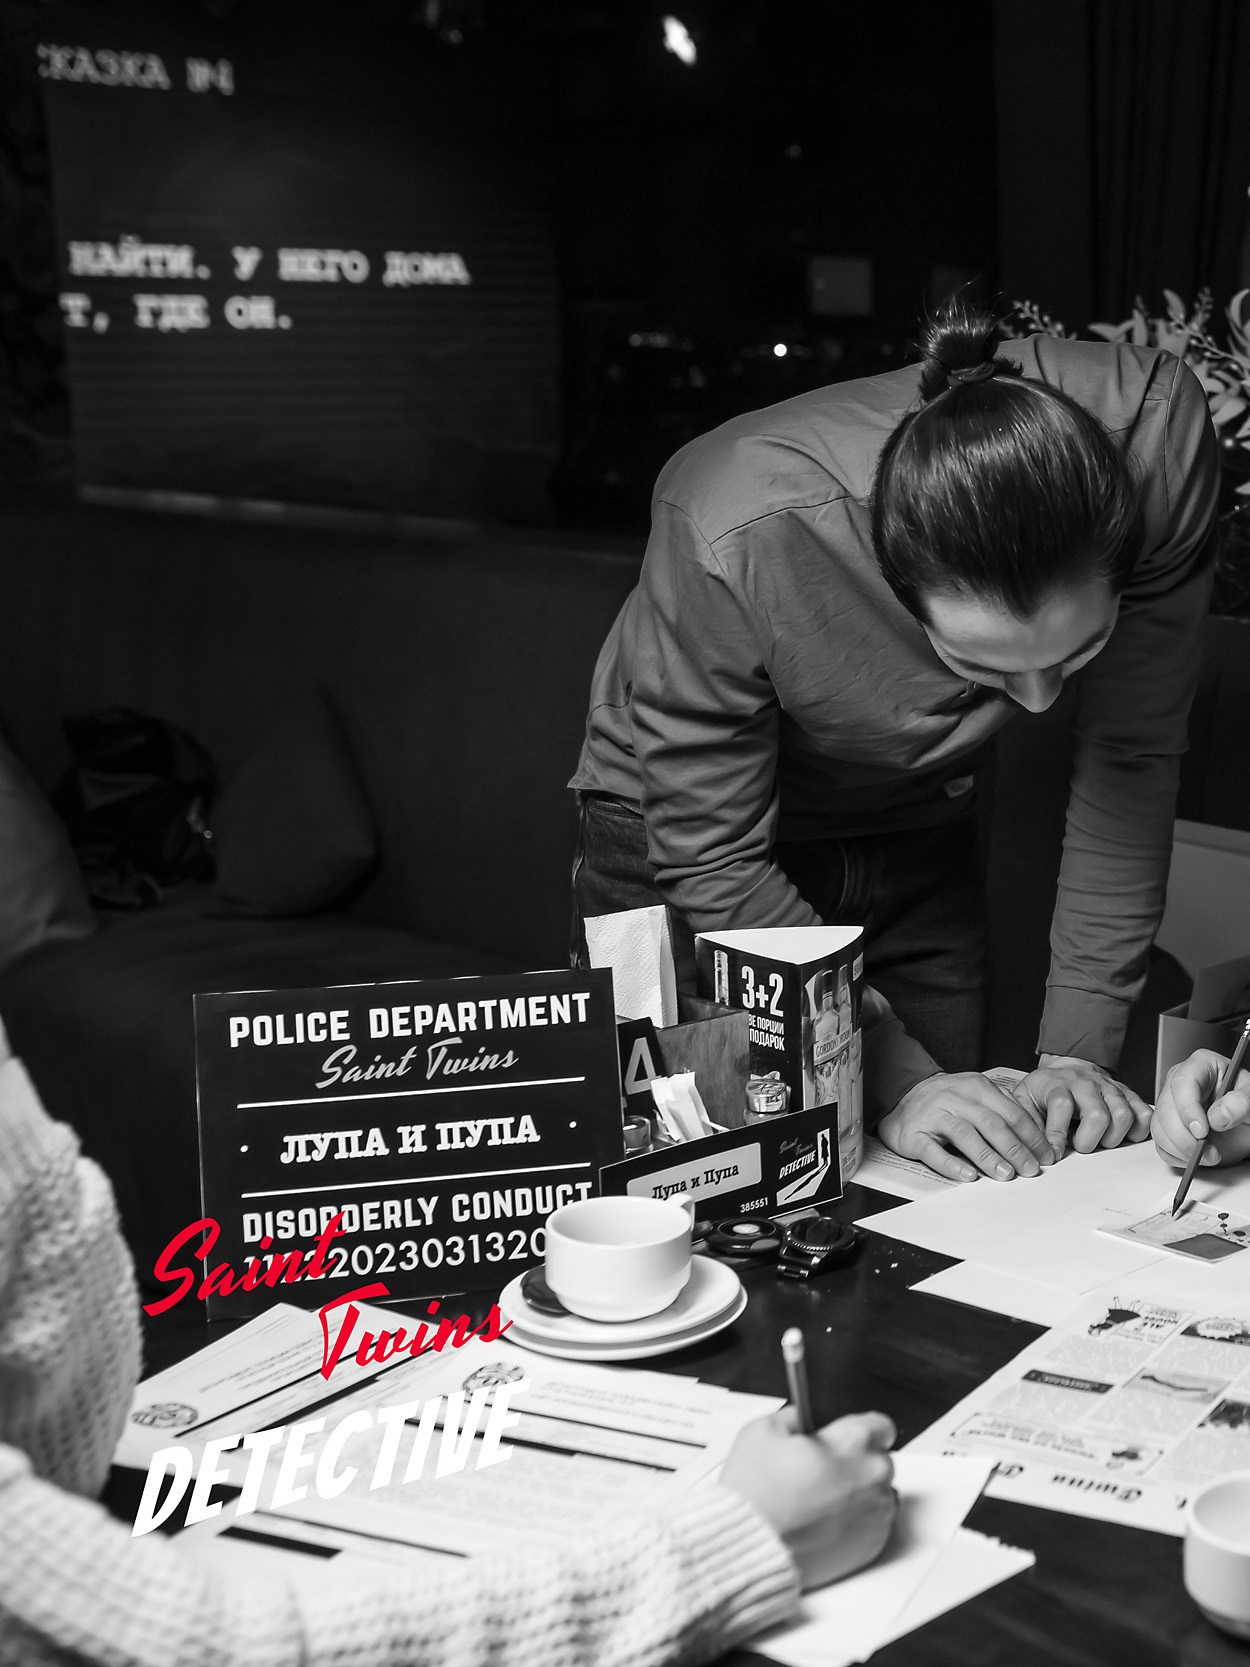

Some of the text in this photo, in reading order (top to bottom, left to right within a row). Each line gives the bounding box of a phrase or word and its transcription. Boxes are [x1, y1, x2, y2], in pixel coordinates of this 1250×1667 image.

[232, 246, 262, 281] У
[277, 247, 370, 283] НЕГО
[382, 251, 472, 287] ДОМА
[133, 294, 210, 332] ГДЕ
[224, 295, 292, 330] ОН.
[742, 965, 784, 1017] 3+2
[229, 992, 590, 1048] POLICE DEPARTMENT
[750, 1028, 785, 1051] ПОДАРОК
[757, 1016, 784, 1035] ПОРЦИИ
[316, 1036, 519, 1089] Saint Twins
[280, 1115, 541, 1164] ЛУПА И ПУПА
[652, 1165, 739, 1201] Лупа и Пупа
[778, 1149, 817, 1180] DETECTIVE
[242, 1182, 592, 1243] DISORDERLY CONDUCT
[740, 1197, 769, 1213] 385551
